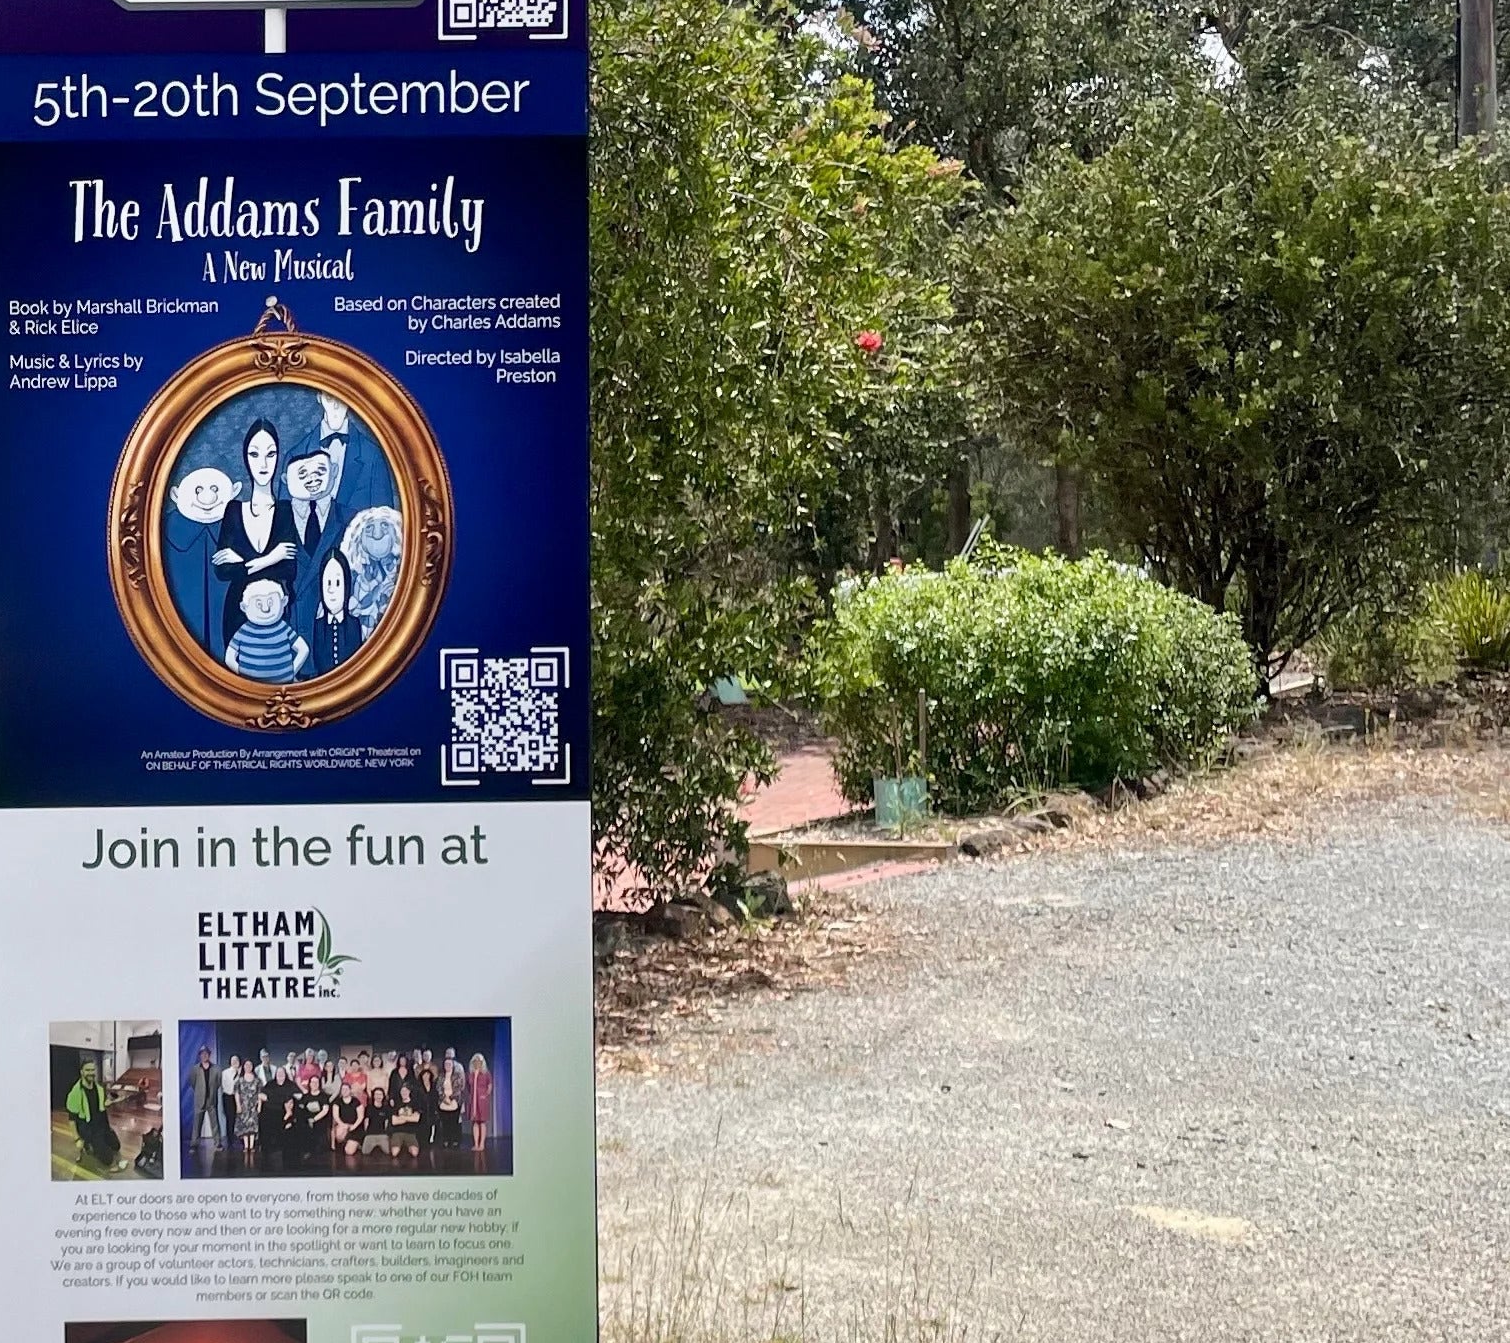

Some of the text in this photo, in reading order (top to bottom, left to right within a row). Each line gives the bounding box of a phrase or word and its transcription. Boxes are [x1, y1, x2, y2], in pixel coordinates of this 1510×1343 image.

[34, 70, 530, 126] 5th-20th September
[69, 176, 484, 255] The Addams Family
[203, 249, 354, 283] A New Musical
[10, 298, 218, 317] Book by Marshall Brickman
[335, 293, 560, 311] Based on Characters created
[9, 317, 98, 335] & Rick Elice
[408, 313, 561, 333] by Charles Addams
[10, 353, 143, 372] Music & Lyrics by
[406, 348, 560, 368] Directed by Isabella
[10, 371, 117, 391] Andrew Lippa
[497, 368, 556, 383] Preston
[82, 824, 488, 869] Join in the fun at
[199, 911, 314, 937] ELTHAM
[199, 941, 313, 971] LITTLE
[199, 976, 341, 1000] THEATRE inc.
